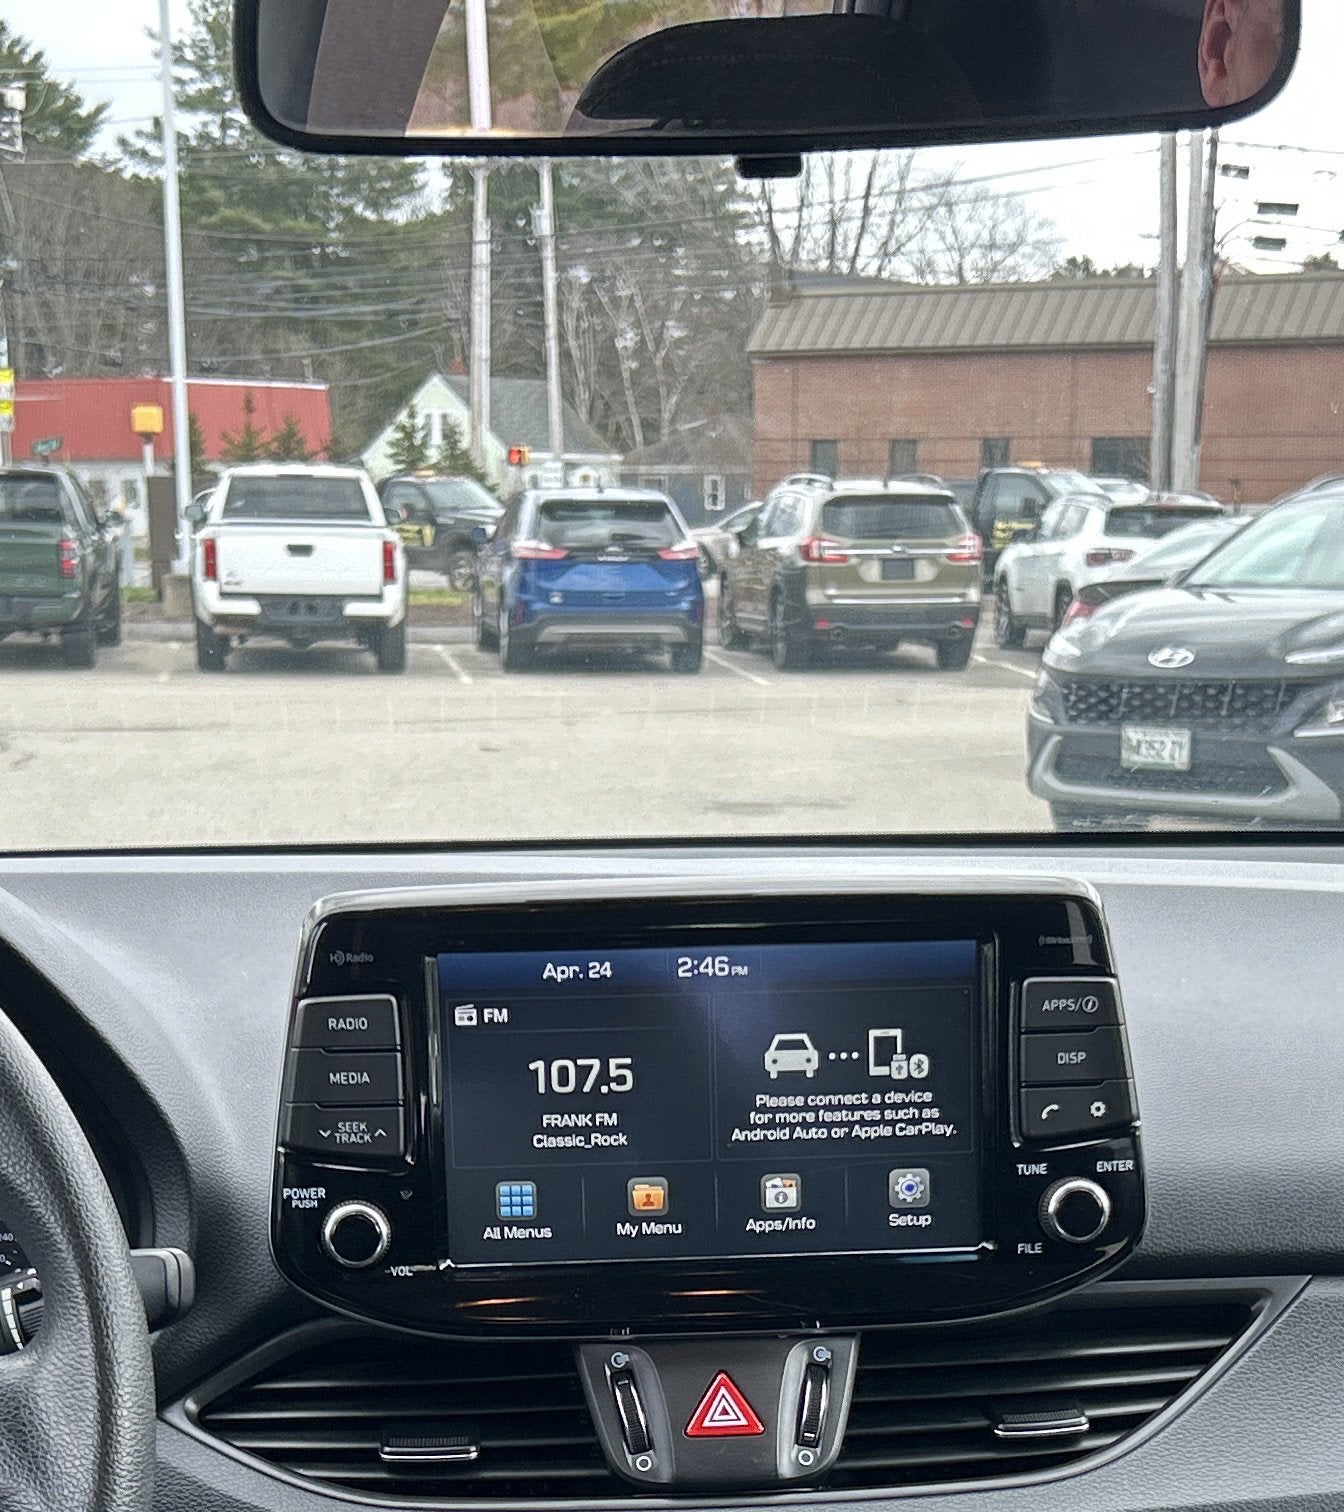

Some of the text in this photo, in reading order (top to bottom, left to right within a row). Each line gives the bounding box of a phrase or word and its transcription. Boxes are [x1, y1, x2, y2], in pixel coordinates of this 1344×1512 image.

[346, 952, 374, 963] Radio
[542, 962, 584, 982] Apr.
[588, 961, 613, 979] 24
[483, 1008, 508, 1023] FM
[327, 1017, 368, 1031] RADIO
[1057, 1052, 1087, 1065] DISP
[329, 1071, 370, 1085] MEDIA
[528, 1057, 634, 1094] 107.5
[756, 1089, 933, 1108] Please connect a device
[542, 1112, 618, 1128] FRANK FM
[749, 1106, 940, 1124] for more features such as
[337, 1122, 368, 1134] SEEK
[731, 1122, 957, 1142] Android Auto or Apple CarPlay.
[334, 1132, 372, 1144] TRACK
[532, 1132, 628, 1149] Classic_Rock
[1016, 1163, 1048, 1175] TUNE
[1096, 1159, 1135, 1172] ENTER
[283, 1187, 326, 1201] POWER
[291, 1199, 318, 1209] PUSH
[746, 1216, 816, 1233] Apps/Info
[888, 1211, 932, 1228] Setup
[483, 1223, 552, 1240] All Menus
[616, 1220, 682, 1237] My Menu
[1017, 1243, 1043, 1255] FILE
